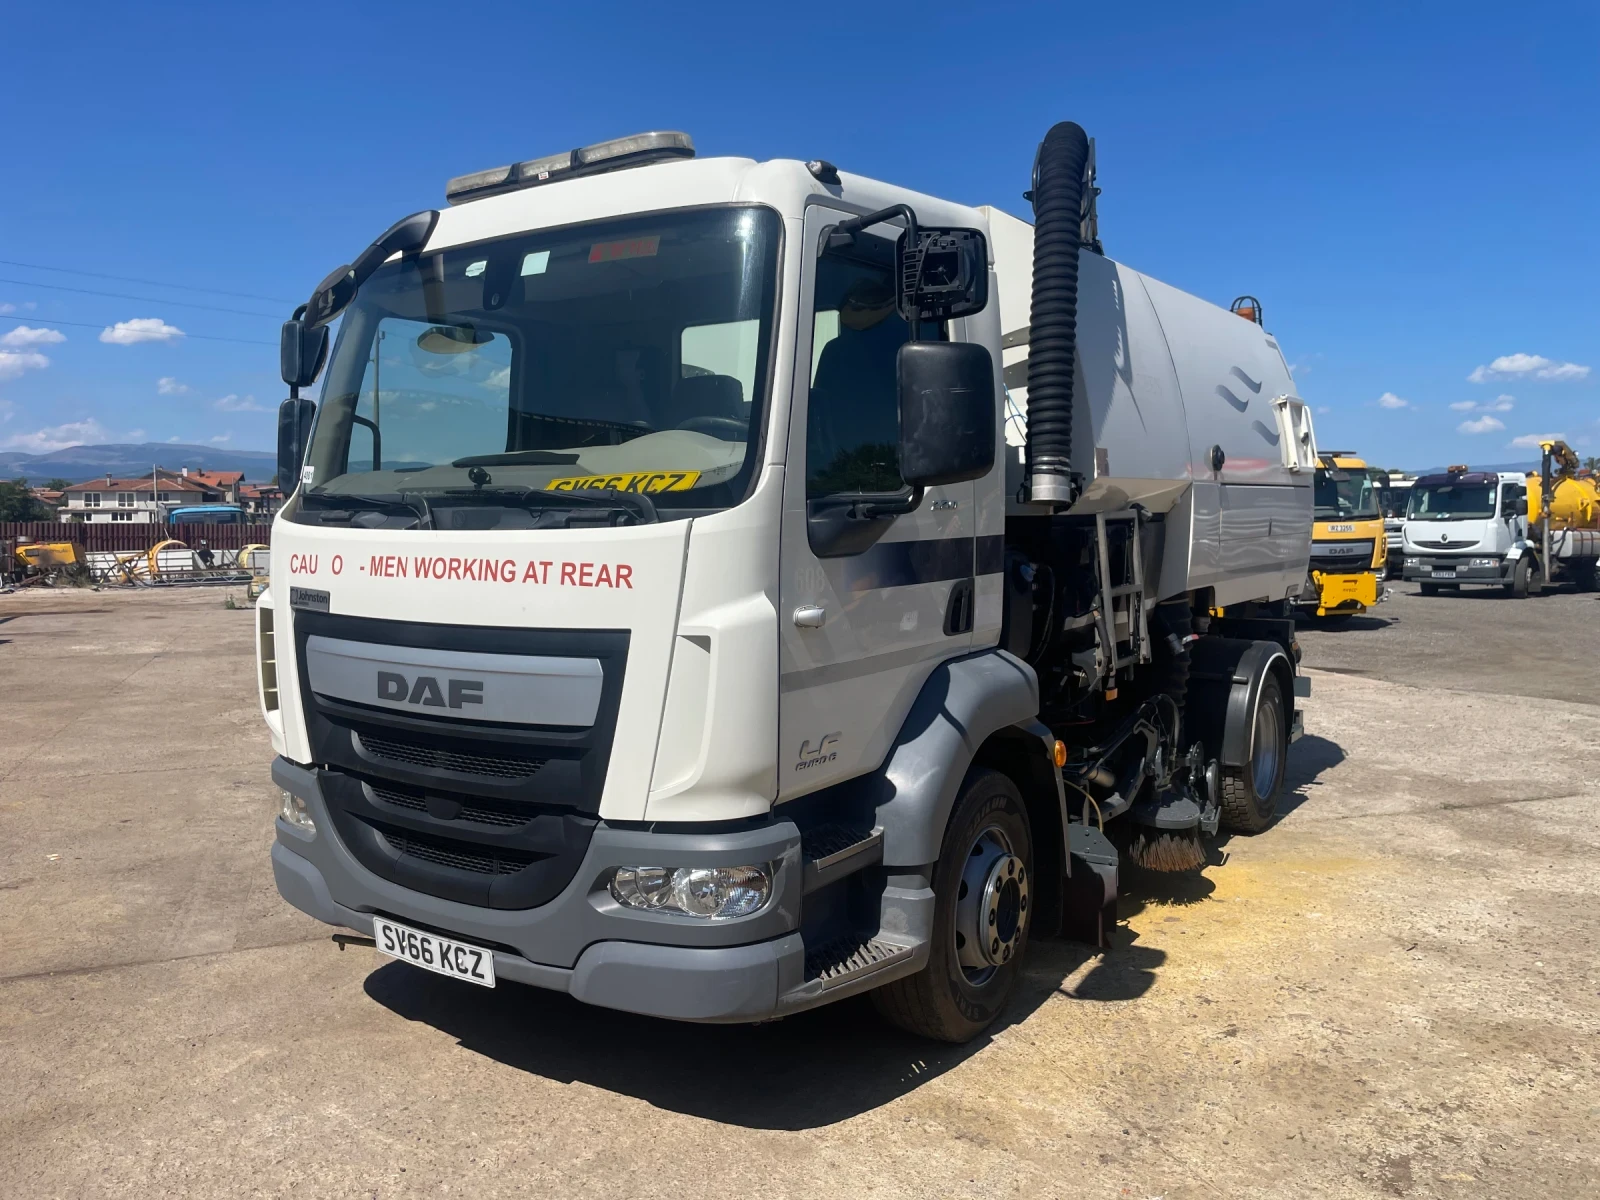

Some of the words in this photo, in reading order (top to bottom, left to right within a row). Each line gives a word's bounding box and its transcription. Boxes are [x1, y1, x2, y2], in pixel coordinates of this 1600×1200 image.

[370, 556, 408, 577] MEN
[414, 556, 516, 583] WORKING
[522, 561, 553, 584] AT
[560, 561, 633, 589] REAR
[299, 590, 328, 604] Johnston
[377, 670, 483, 709] DAF
[799, 731, 842, 761] LF
[795, 755, 827, 771] EURO
[382, 924, 434, 965] SV66
[438, 941, 485, 979] KCZ
